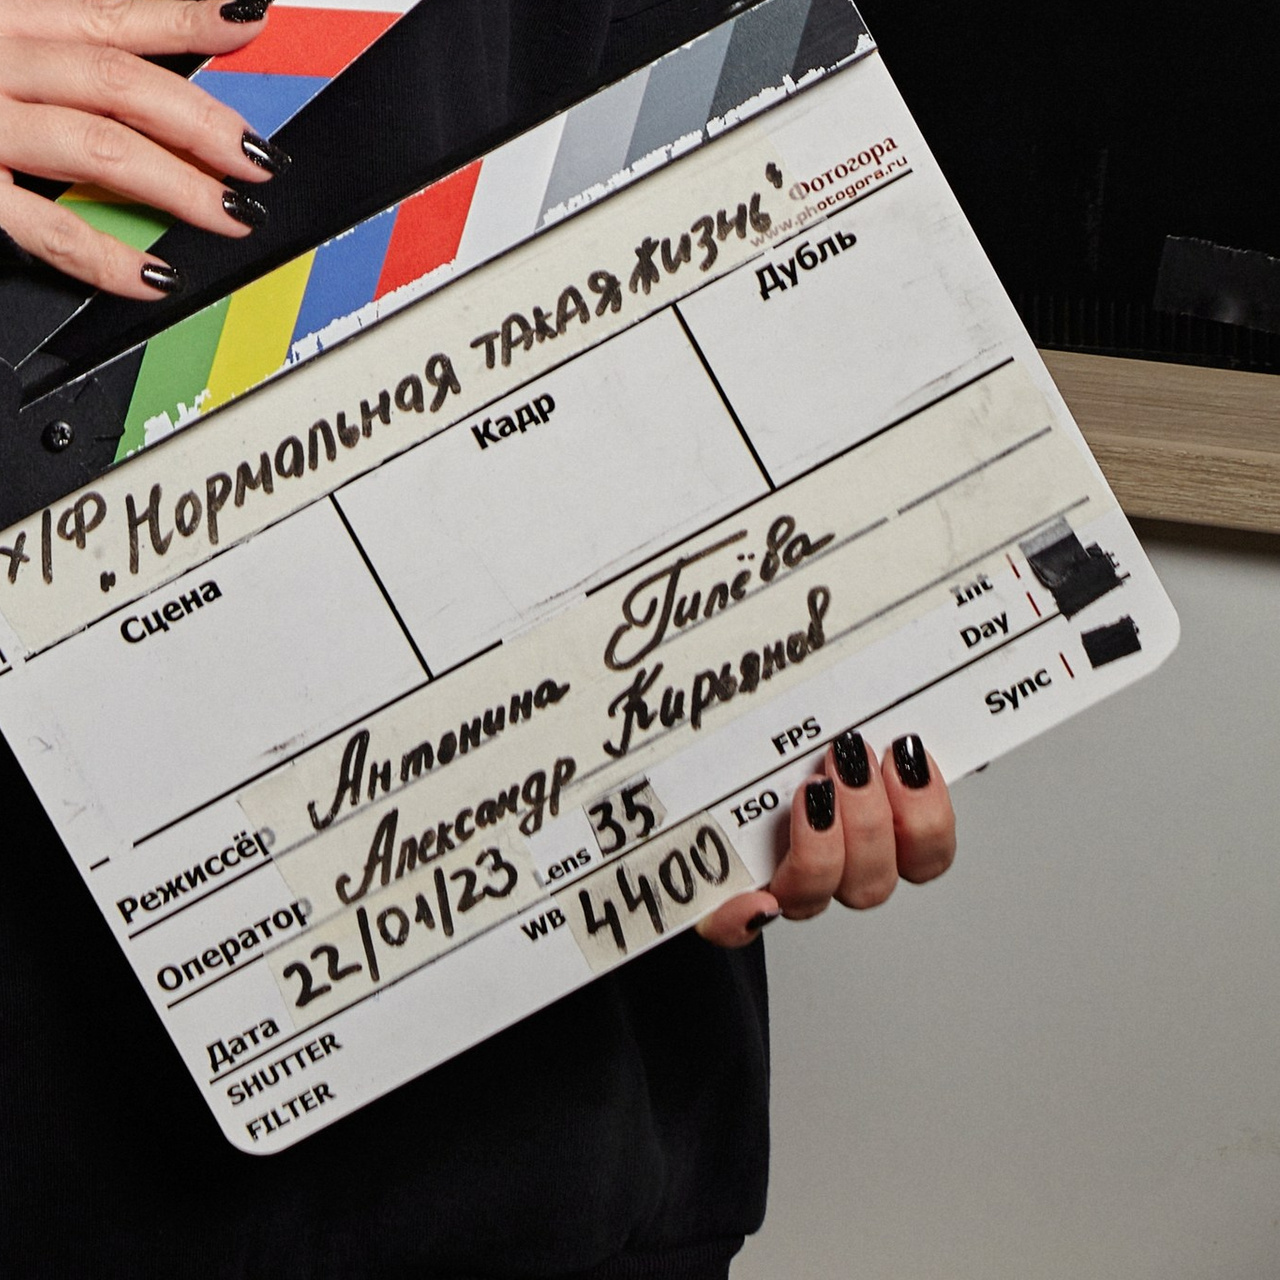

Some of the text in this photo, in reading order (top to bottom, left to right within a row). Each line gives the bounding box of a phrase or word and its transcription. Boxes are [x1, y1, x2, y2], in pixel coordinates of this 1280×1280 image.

[750, 155, 908, 248] www.photogora.ru
[788, 136, 898, 201] Фотогора
[755, 230, 858, 301] Дубль
[471, 392, 557, 450] Кадр
[120, 578, 222, 645] Сцена
[959, 611, 1010, 649] Day
[984, 667, 1052, 715] Sync
[308, 678, 570, 830] Антонина
[335, 585, 832, 906] Александр Кирьянов
[771, 717, 822, 756] FPS
[587, 777, 656, 857] 35
[731, 789, 780, 828] ISO
[116, 827, 276, 925] Режиссёр
[578, 824, 731, 954] 4400
[155, 898, 313, 993] Оператор
[283, 848, 518, 1008] 22/01/23
[520, 907, 567, 942] WB
[205, 1016, 280, 1072] Дата
[227, 1033, 343, 1107] SHUTTER
[245, 1082, 336, 1142] FILTER
